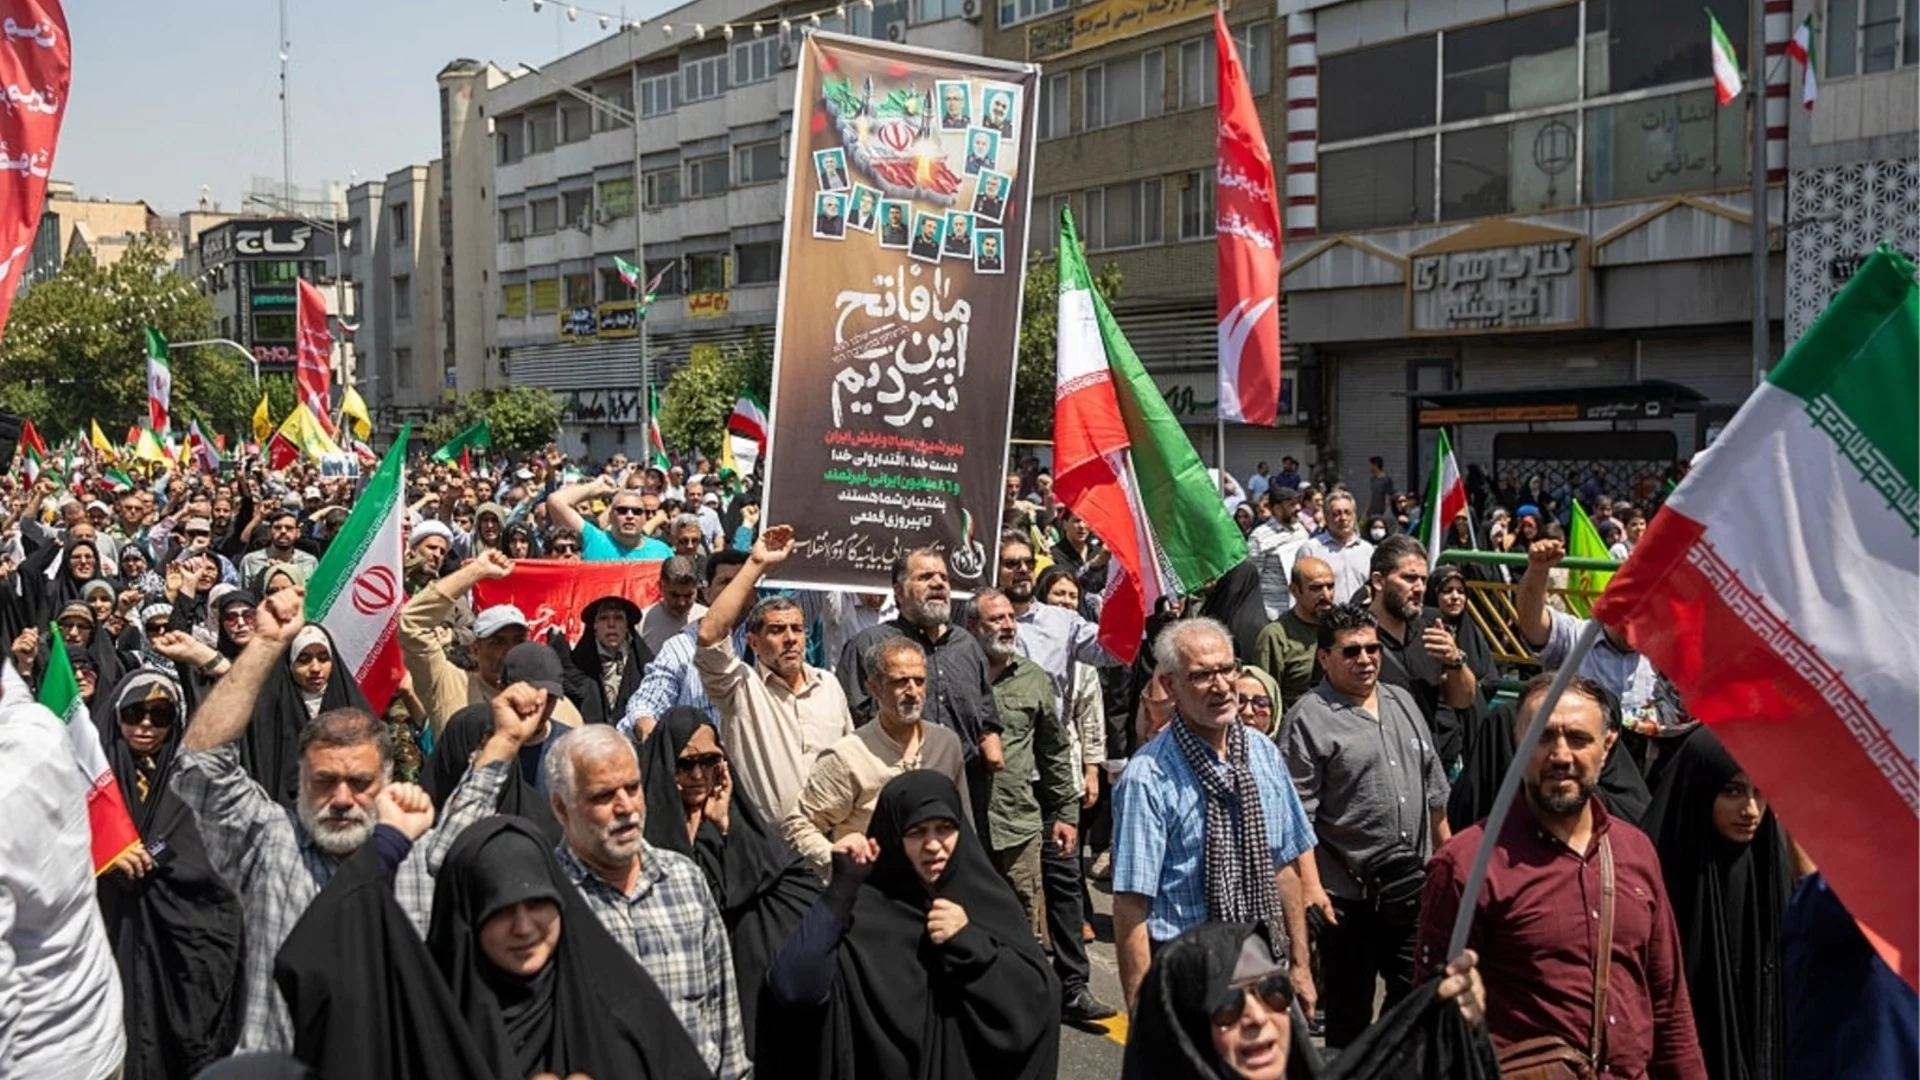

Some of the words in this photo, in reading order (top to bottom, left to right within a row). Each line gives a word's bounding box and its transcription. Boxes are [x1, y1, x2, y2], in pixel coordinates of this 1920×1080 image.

[235, 226, 313, 254] گاج
[834, 262, 931, 345] فاتح
[932, 266, 972, 324] ما
[894, 322, 969, 378] این
[831, 448, 853, 461] خدا
[929, 460, 959, 473] دست
[836, 488, 880, 505] هستند
[879, 492, 903, 506] شما
[902, 495, 947, 514] پشتیبان
[849, 509, 885, 526] قطعی
[884, 512, 921, 531] پیروزی
